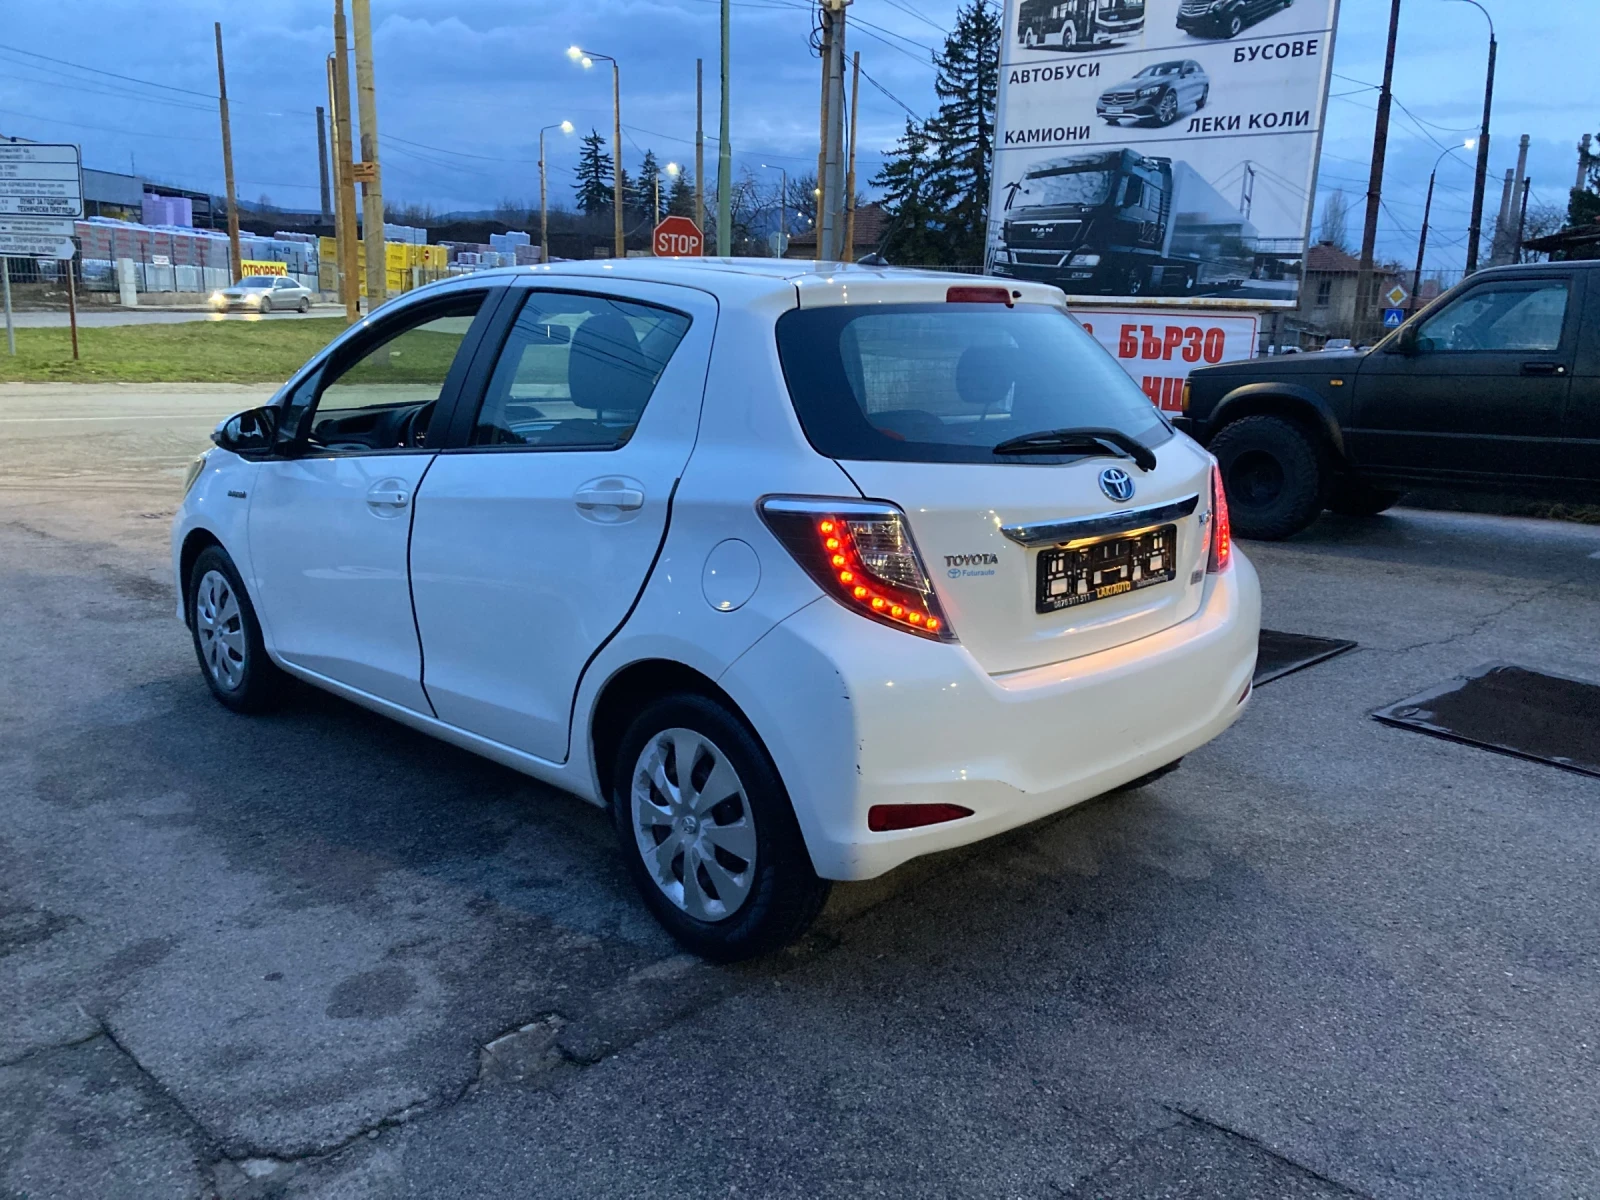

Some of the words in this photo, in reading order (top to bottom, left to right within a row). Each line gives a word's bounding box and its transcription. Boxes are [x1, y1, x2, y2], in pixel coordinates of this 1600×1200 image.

[1233, 39, 1319, 63] БУСОВЕ
[1009, 62, 1100, 84] АВТОБУСИ
[1187, 115, 1241, 133] ЛЕКИ
[1248, 110, 1310, 129] КОЛИ
[1004, 125, 1091, 144] КАМИОНИ
[658, 232, 699, 254] STOP
[242, 264, 288, 277] ОТВОРЕНО
[1118, 324, 1225, 364] БЪРЗО
[944, 553, 999, 567] TOYOTA
